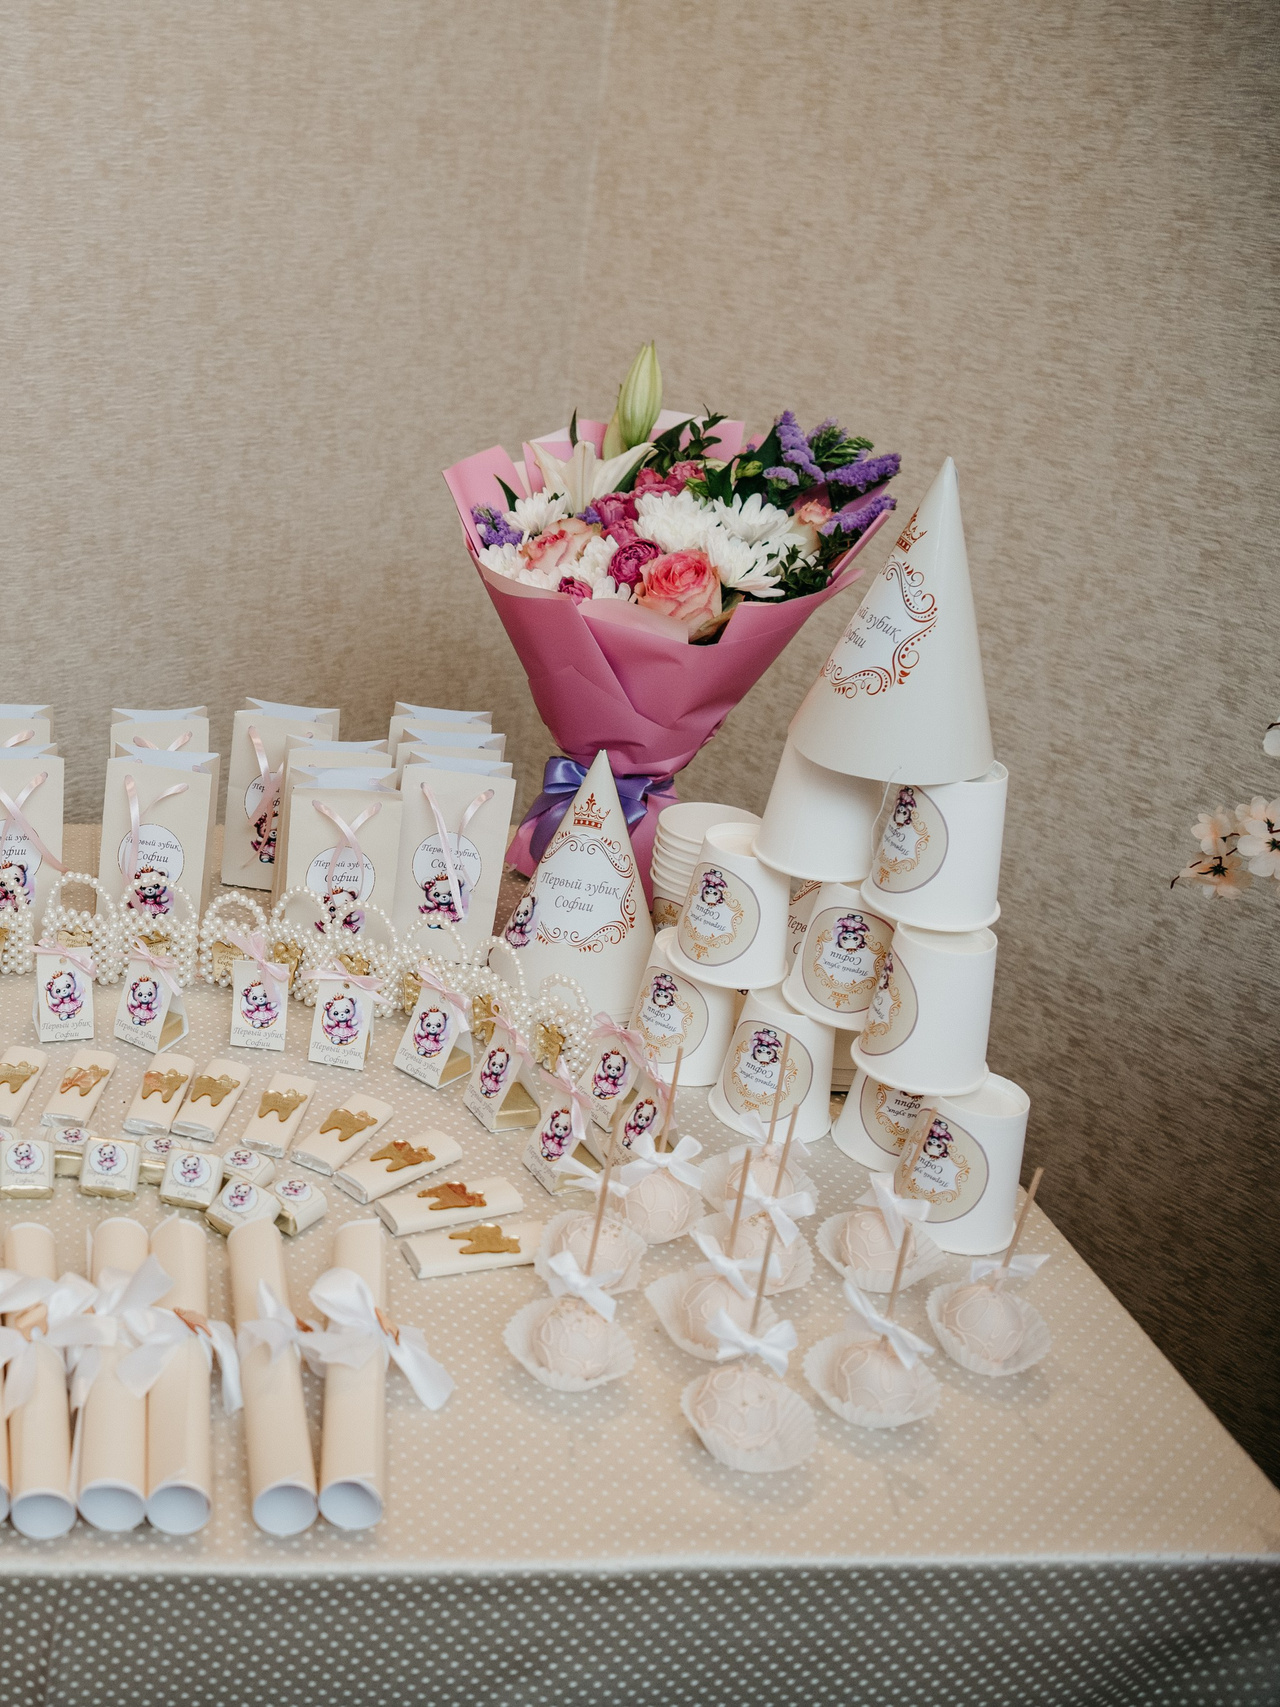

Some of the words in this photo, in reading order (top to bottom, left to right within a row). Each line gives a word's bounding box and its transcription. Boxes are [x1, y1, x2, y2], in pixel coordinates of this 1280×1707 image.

[866, 614, 902, 644] зубик
[157, 840, 181, 852] зубик
[454, 848, 479, 860] зубик
[346, 860, 372, 870] зубк
[540, 871, 582, 890] Первый
[584, 880, 621, 900] зубик
[554, 894, 594, 913] Софии
[787, 915, 808, 934] Перв
[829, 949, 862, 965] Софии
[41, 1022, 70, 1032] Первый
[70, 1019, 93, 1029] зубик
[54, 1030, 80, 1040] Софии
[233, 1026, 262, 1038] Первый
[263, 1030, 285, 1041] зубик
[245, 1038, 271, 1049] Софии
[311, 1041, 341, 1054] Первый
[341, 1046, 365, 1060] зубик
[323, 1054, 350, 1067] Софии
[745, 1061, 774, 1078] Софии
[894, 1098, 921, 1109] офии
